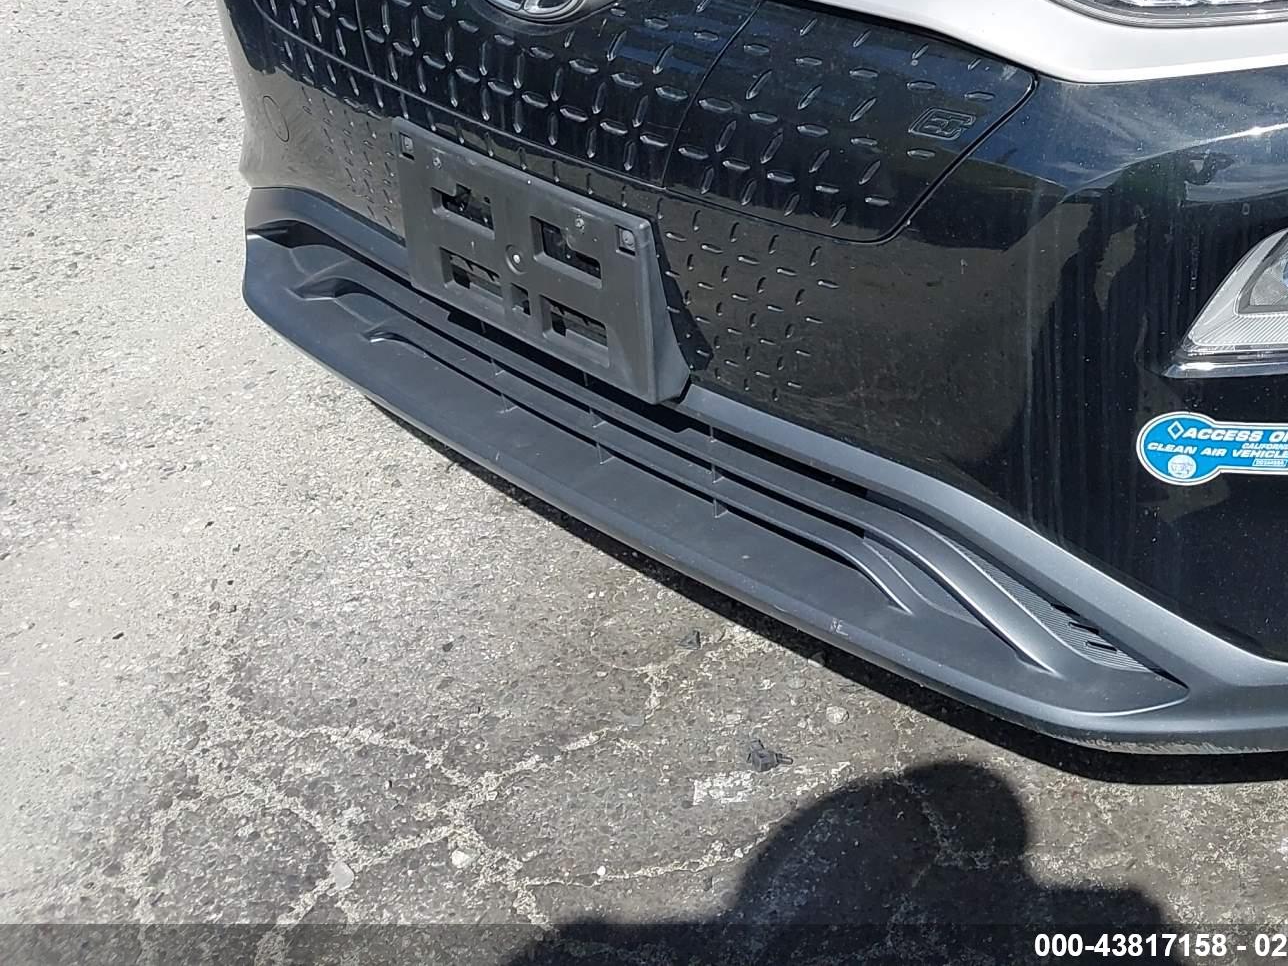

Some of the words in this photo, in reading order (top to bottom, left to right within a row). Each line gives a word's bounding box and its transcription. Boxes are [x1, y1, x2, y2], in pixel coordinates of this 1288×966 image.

[1181, 427, 1264, 442] ACCESS
[1146, 442, 1198, 455] CLEAN
[1200, 447, 1227, 457] AIR
